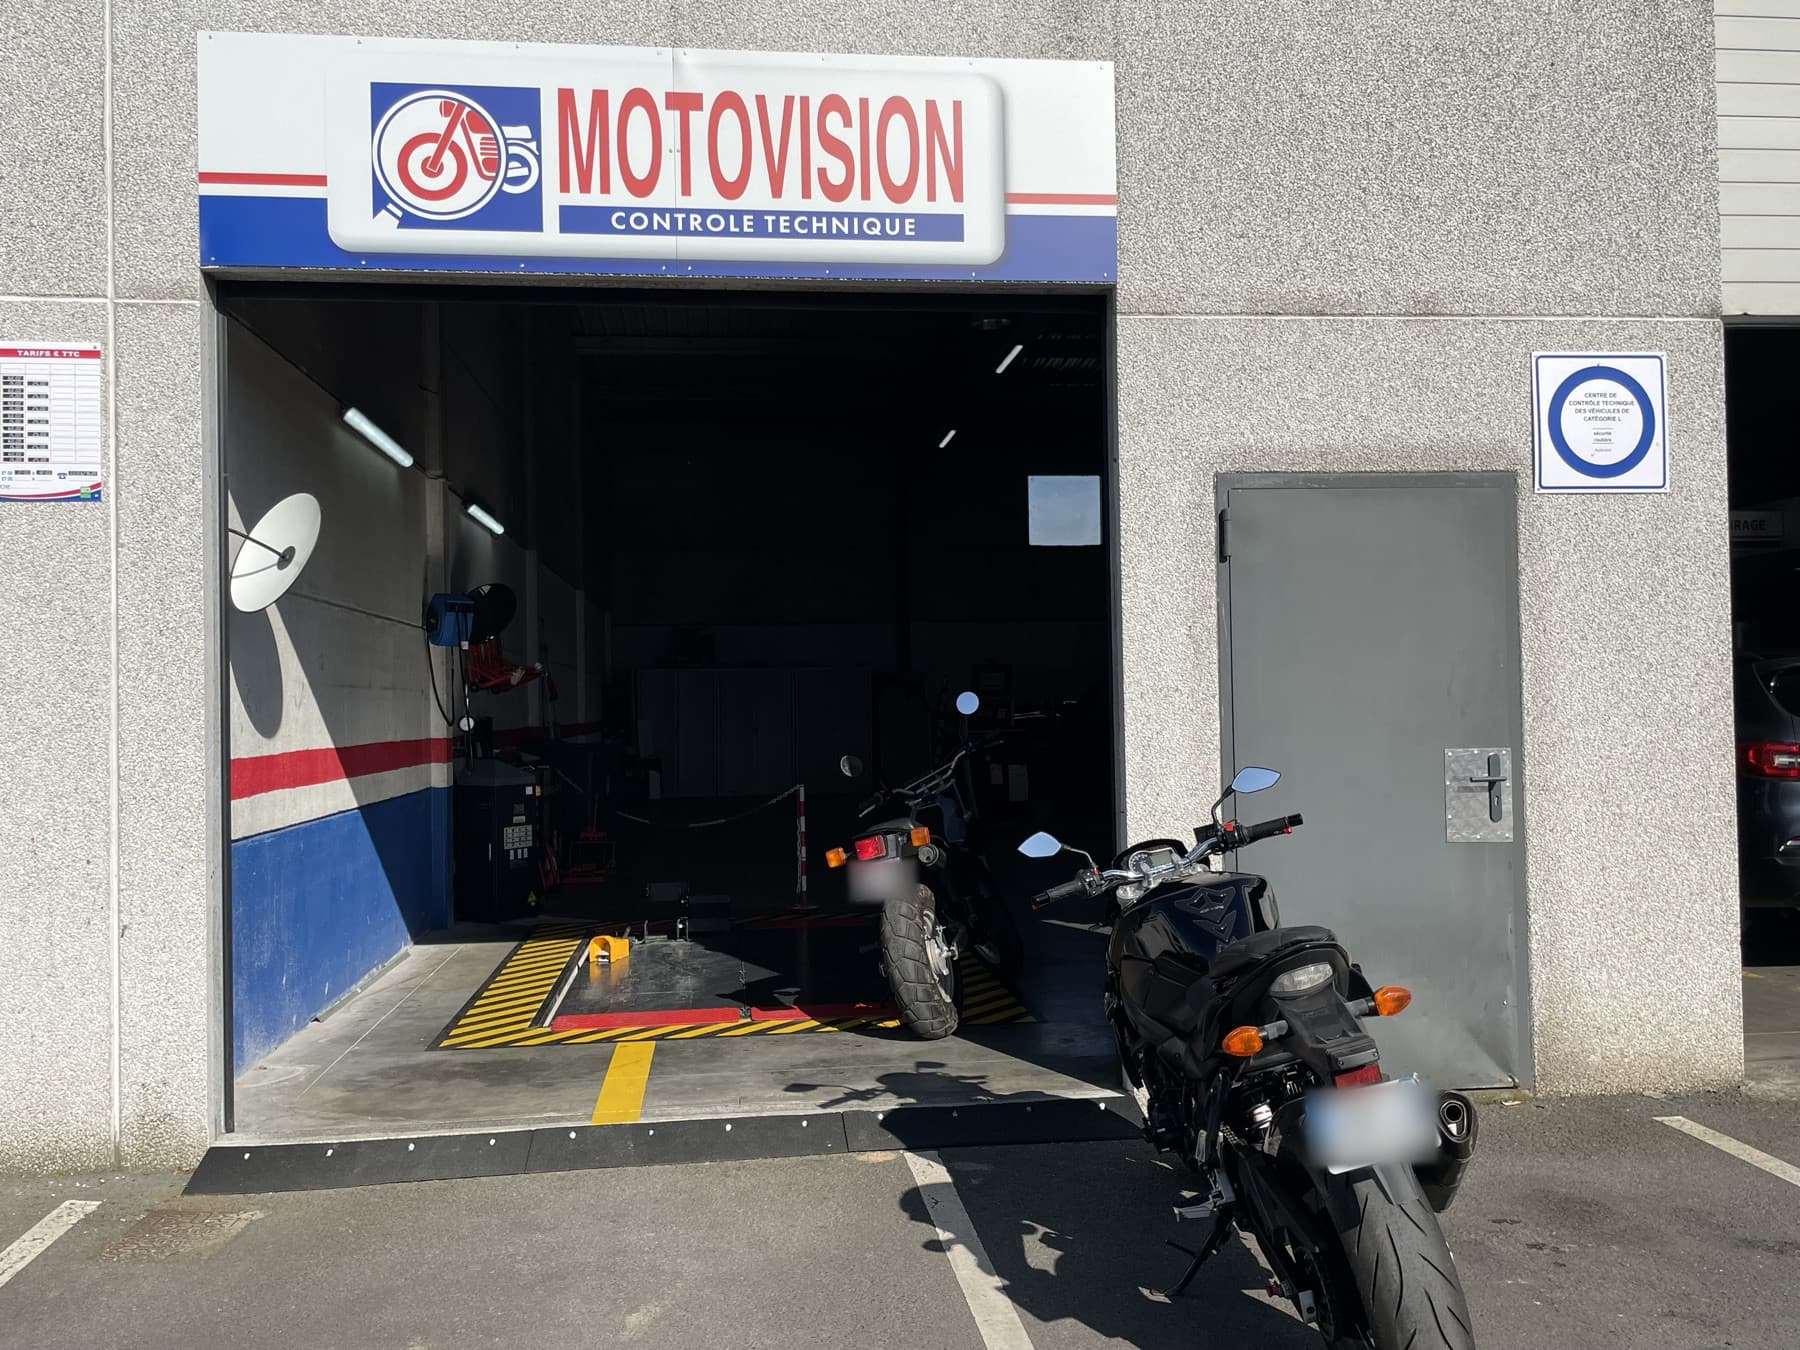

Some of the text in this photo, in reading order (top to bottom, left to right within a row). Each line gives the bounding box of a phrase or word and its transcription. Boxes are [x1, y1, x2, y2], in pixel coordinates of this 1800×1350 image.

[558, 87, 964, 204] MOTOVISION
[611, 212, 916, 236] CONTROLE TECHNIQUE
